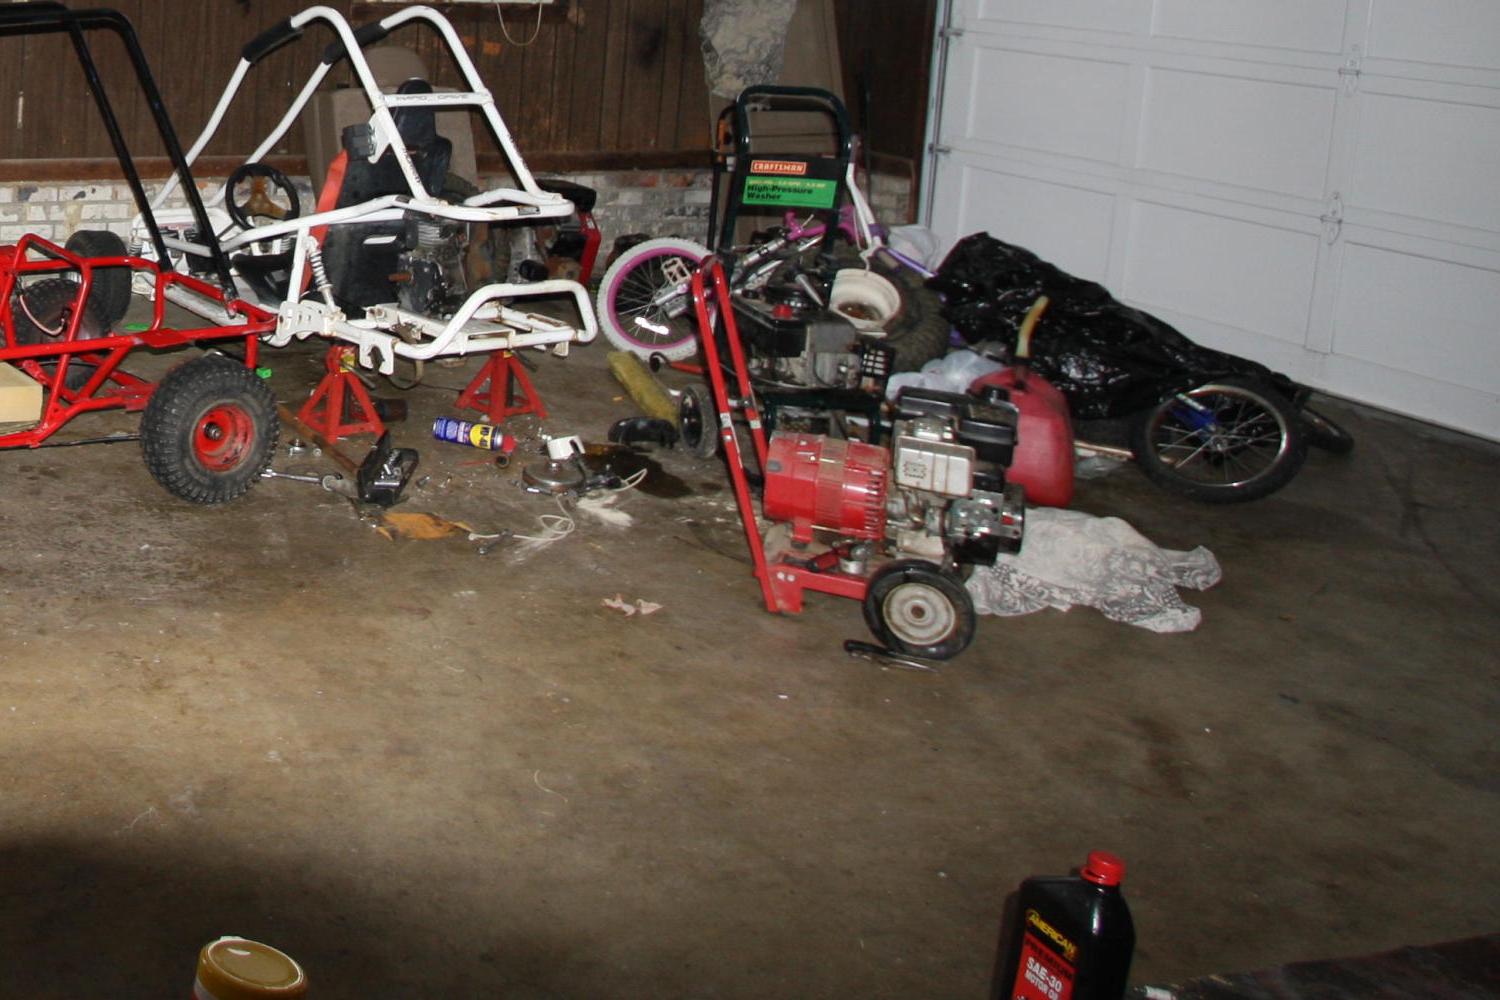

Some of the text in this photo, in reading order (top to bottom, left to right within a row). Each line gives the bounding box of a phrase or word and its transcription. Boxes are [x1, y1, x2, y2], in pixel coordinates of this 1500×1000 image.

[753, 162, 804, 172] CRAFTSMAN
[747, 184, 814, 195] High-Pressure
[747, 191, 782, 200] Washer
[1028, 913, 1077, 953] AMERICAN
[1025, 970, 1048, 994] MOTOR
[1027, 957, 1062, 992] SAE-30
